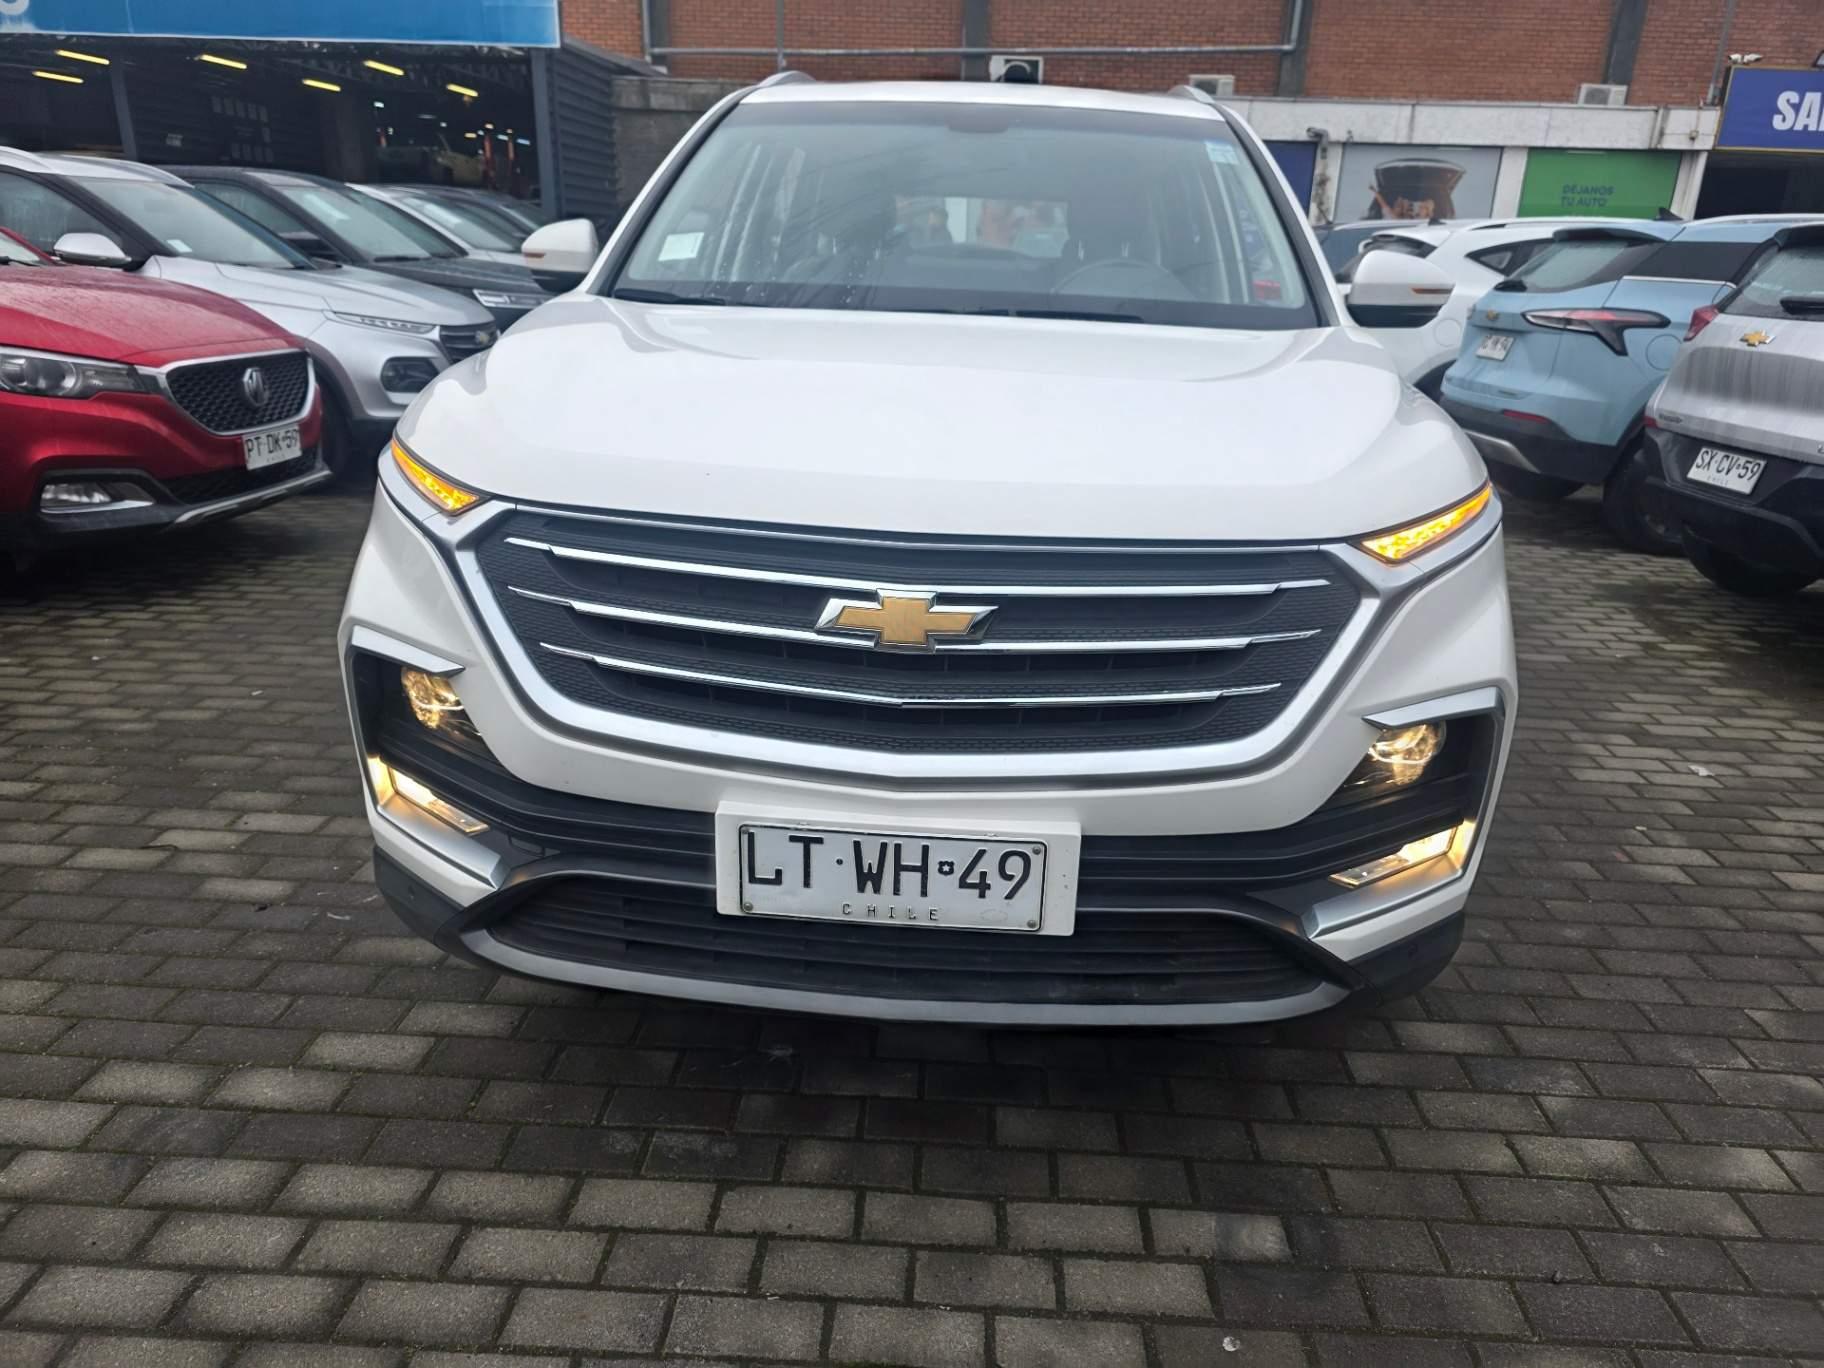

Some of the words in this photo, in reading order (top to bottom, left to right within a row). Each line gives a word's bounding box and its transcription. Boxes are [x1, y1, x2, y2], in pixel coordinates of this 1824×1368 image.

[1772, 90, 1824, 131] SA
[1577, 196, 1608, 208] AUTO
[842, 903, 939, 921] CHILE
